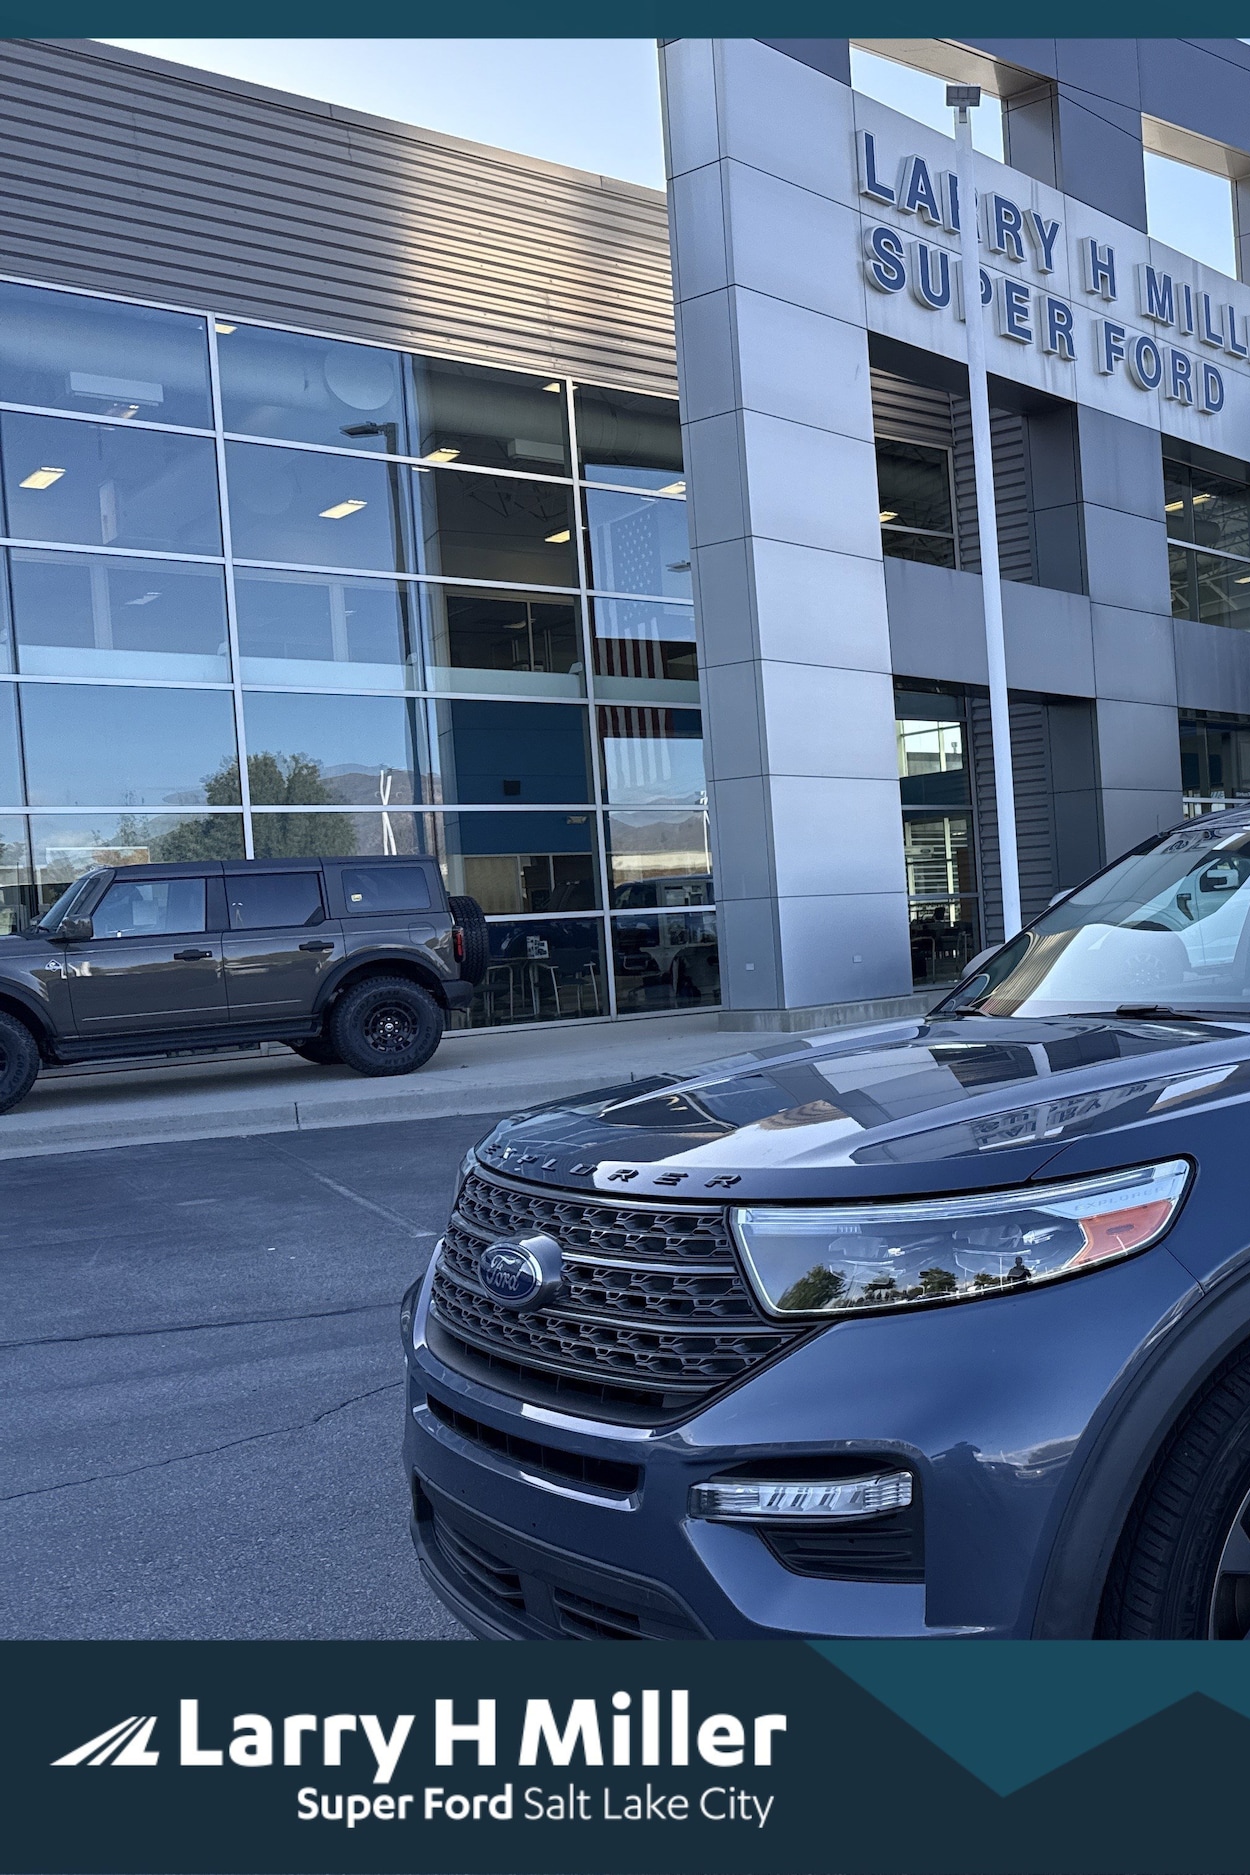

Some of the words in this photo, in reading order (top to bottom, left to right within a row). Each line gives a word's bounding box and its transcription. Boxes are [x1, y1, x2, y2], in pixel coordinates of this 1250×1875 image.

[1082, 236, 1117, 301] H
[1096, 317, 1225, 415] FORD
[484, 1142, 741, 1189] EXPLORER
[1074, 1186, 1165, 1212] EXPLORER
[486, 1254, 520, 1293] Ford
